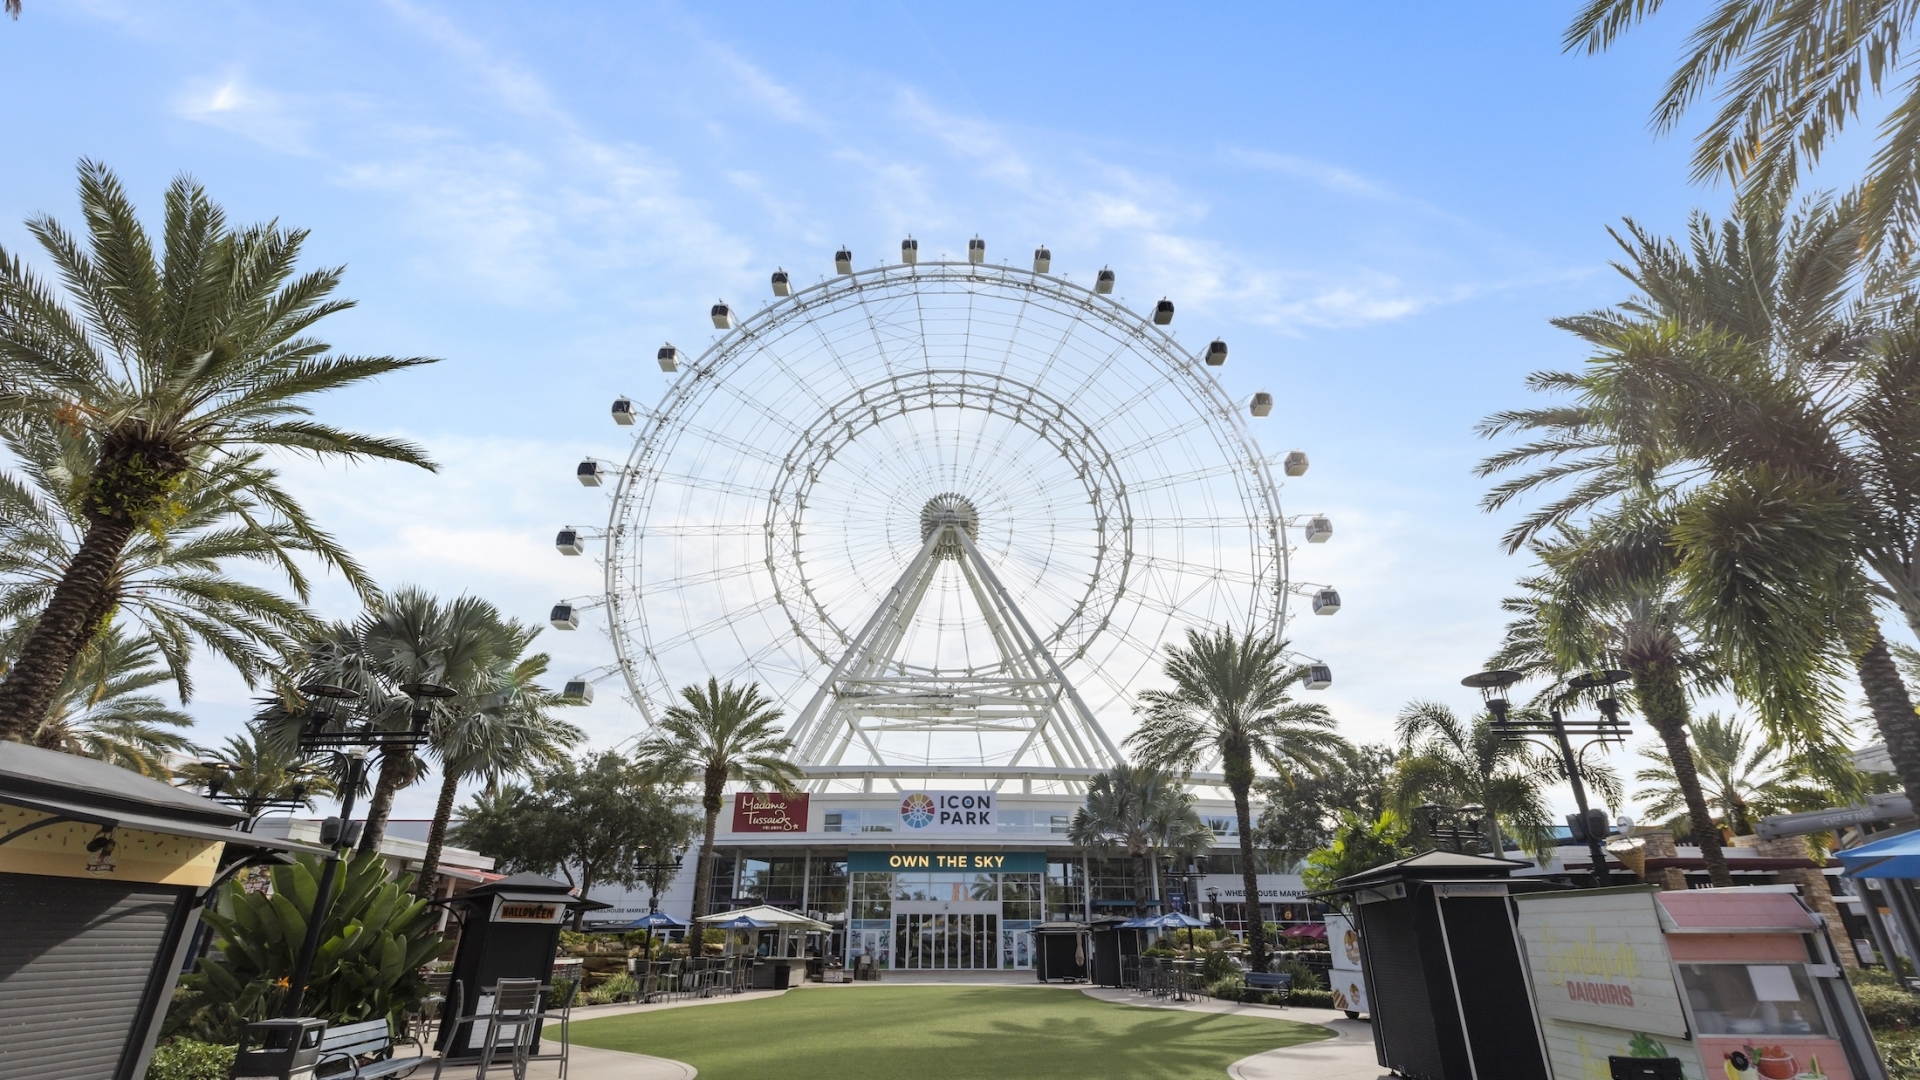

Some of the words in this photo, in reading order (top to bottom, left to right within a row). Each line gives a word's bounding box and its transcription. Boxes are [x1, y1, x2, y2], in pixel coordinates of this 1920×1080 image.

[742, 796, 787, 811] Madame
[940, 795, 990, 809] ICON
[742, 809, 792, 831] Tussauds
[940, 811, 990, 825] PARK
[889, 855, 929, 868] OWN
[937, 855, 967, 868] THE
[974, 855, 1005, 868] SKY
[502, 906, 554, 919] HALLOWEEN
[1542, 921, 1642, 986] Sunshine
[1566, 980, 1634, 1008] DAIQUIRIS
